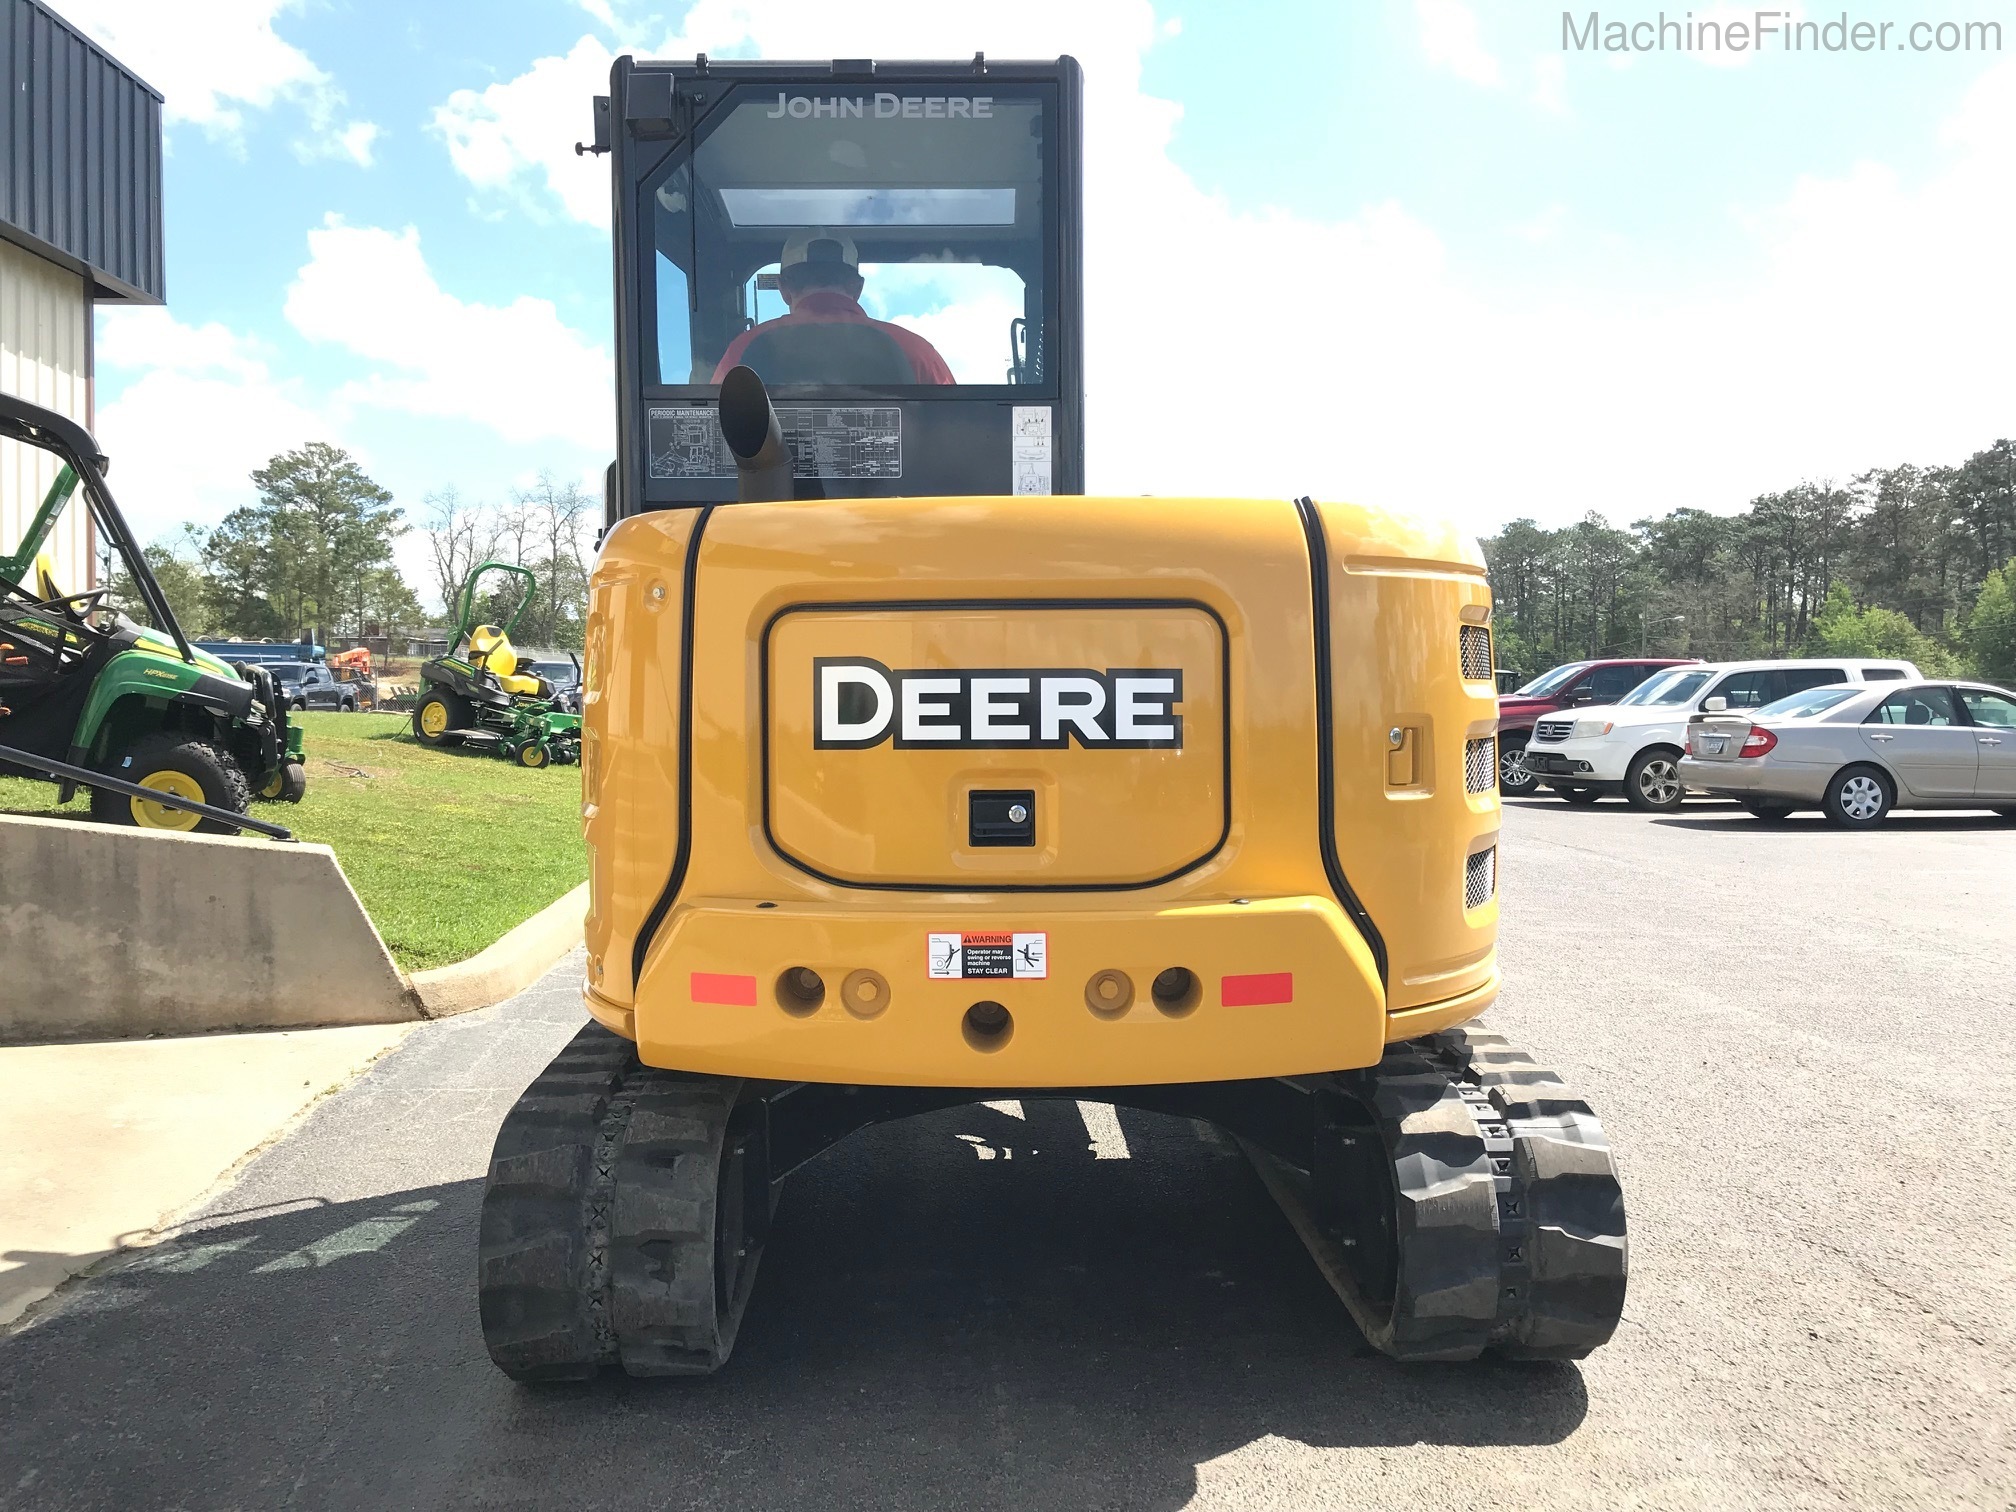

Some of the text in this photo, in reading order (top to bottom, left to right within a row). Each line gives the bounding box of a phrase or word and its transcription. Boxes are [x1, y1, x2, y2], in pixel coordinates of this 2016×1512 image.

[766, 92, 994, 119] JOHN DEERE
[819, 662, 1177, 743] DEERE
[971, 935, 1012, 943] WARNING
